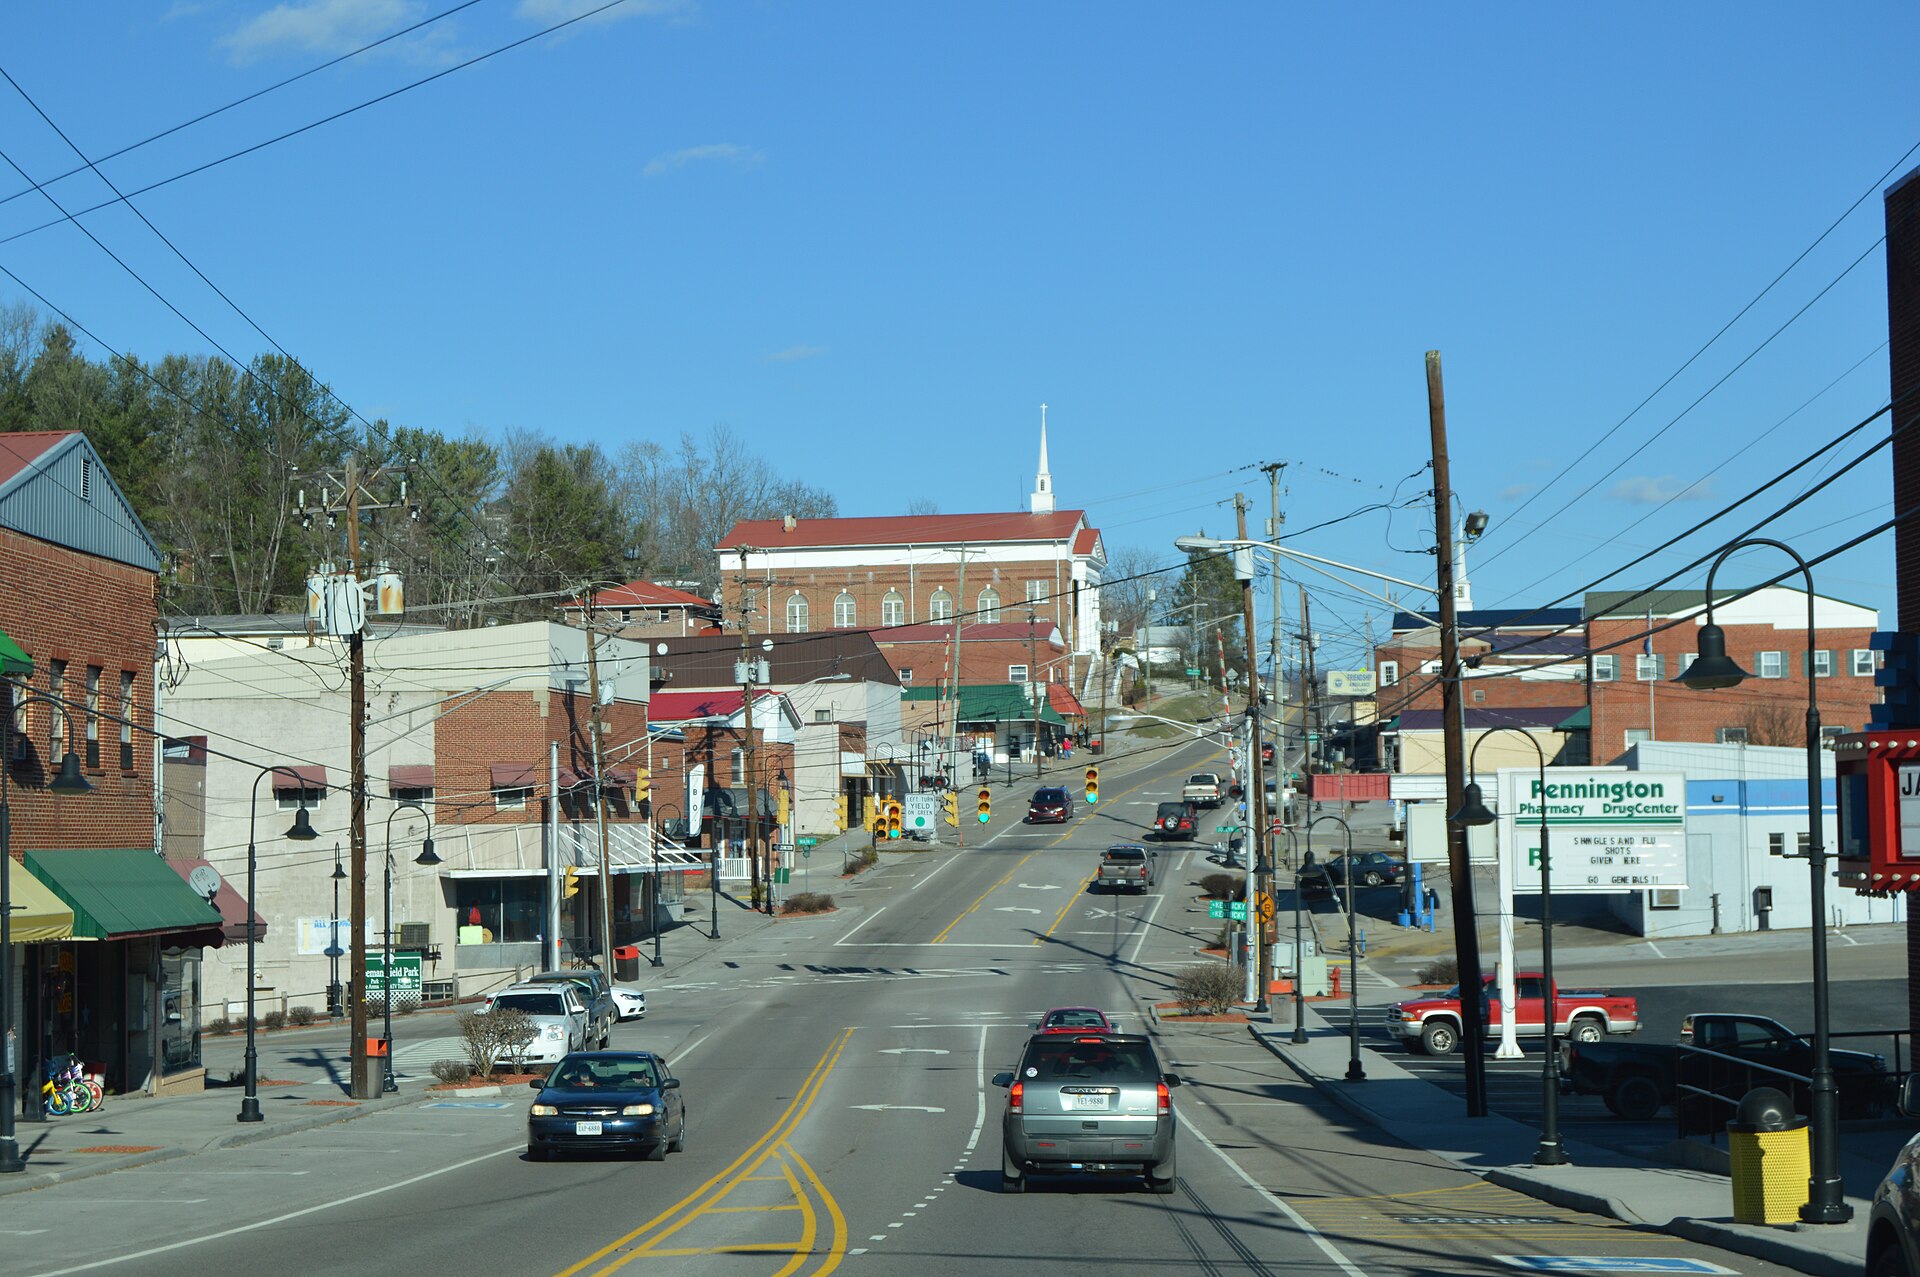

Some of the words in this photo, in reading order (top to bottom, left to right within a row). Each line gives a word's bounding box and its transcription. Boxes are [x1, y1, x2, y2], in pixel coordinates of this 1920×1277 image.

[1531, 777, 1664, 803] Pennington
[1519, 802, 1585, 816] Pharmacy
[1602, 802, 1679, 817] DrugCenter
[1617, 836, 1635, 845] AND
[1642, 836, 1656, 845] FLU
[1605, 846, 1632, 855] SHOTS
[1590, 856, 1614, 865] GIVEN
[1623, 856, 1641, 865] HERE
[1587, 875, 1599, 884] GO
[403, 966, 419, 977] Park
